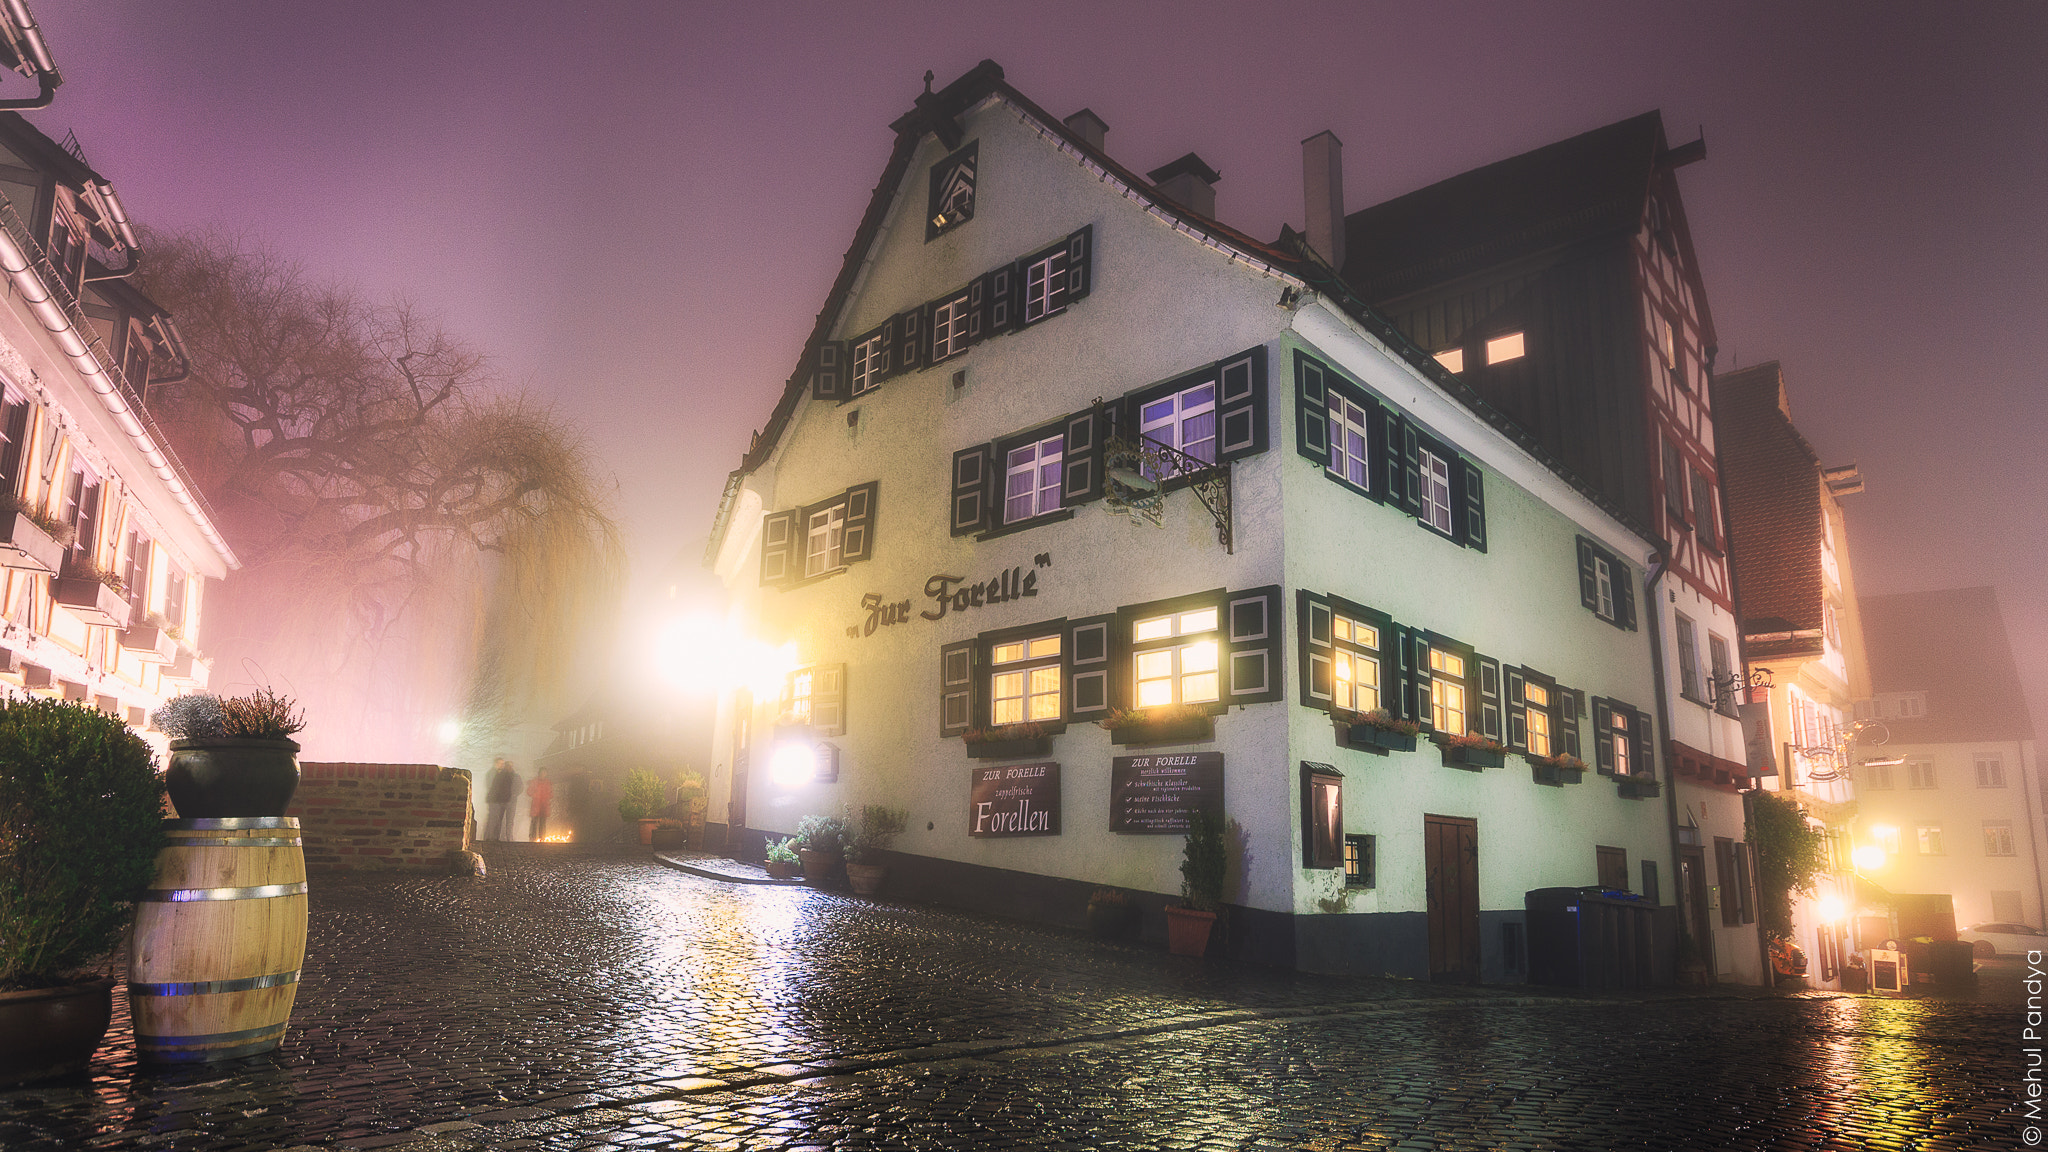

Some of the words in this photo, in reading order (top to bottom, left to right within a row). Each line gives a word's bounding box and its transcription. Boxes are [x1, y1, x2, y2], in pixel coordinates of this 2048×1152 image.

[1131, 758, 1150, 768] ZUR
[1155, 755, 1198, 767] FORELLE
[982, 770, 1001, 781] ZUR
[1006, 766, 1047, 780] FORELLE
[995, 784, 1033, 800] zappelfrische
[974, 798, 1050, 833] Forellen
